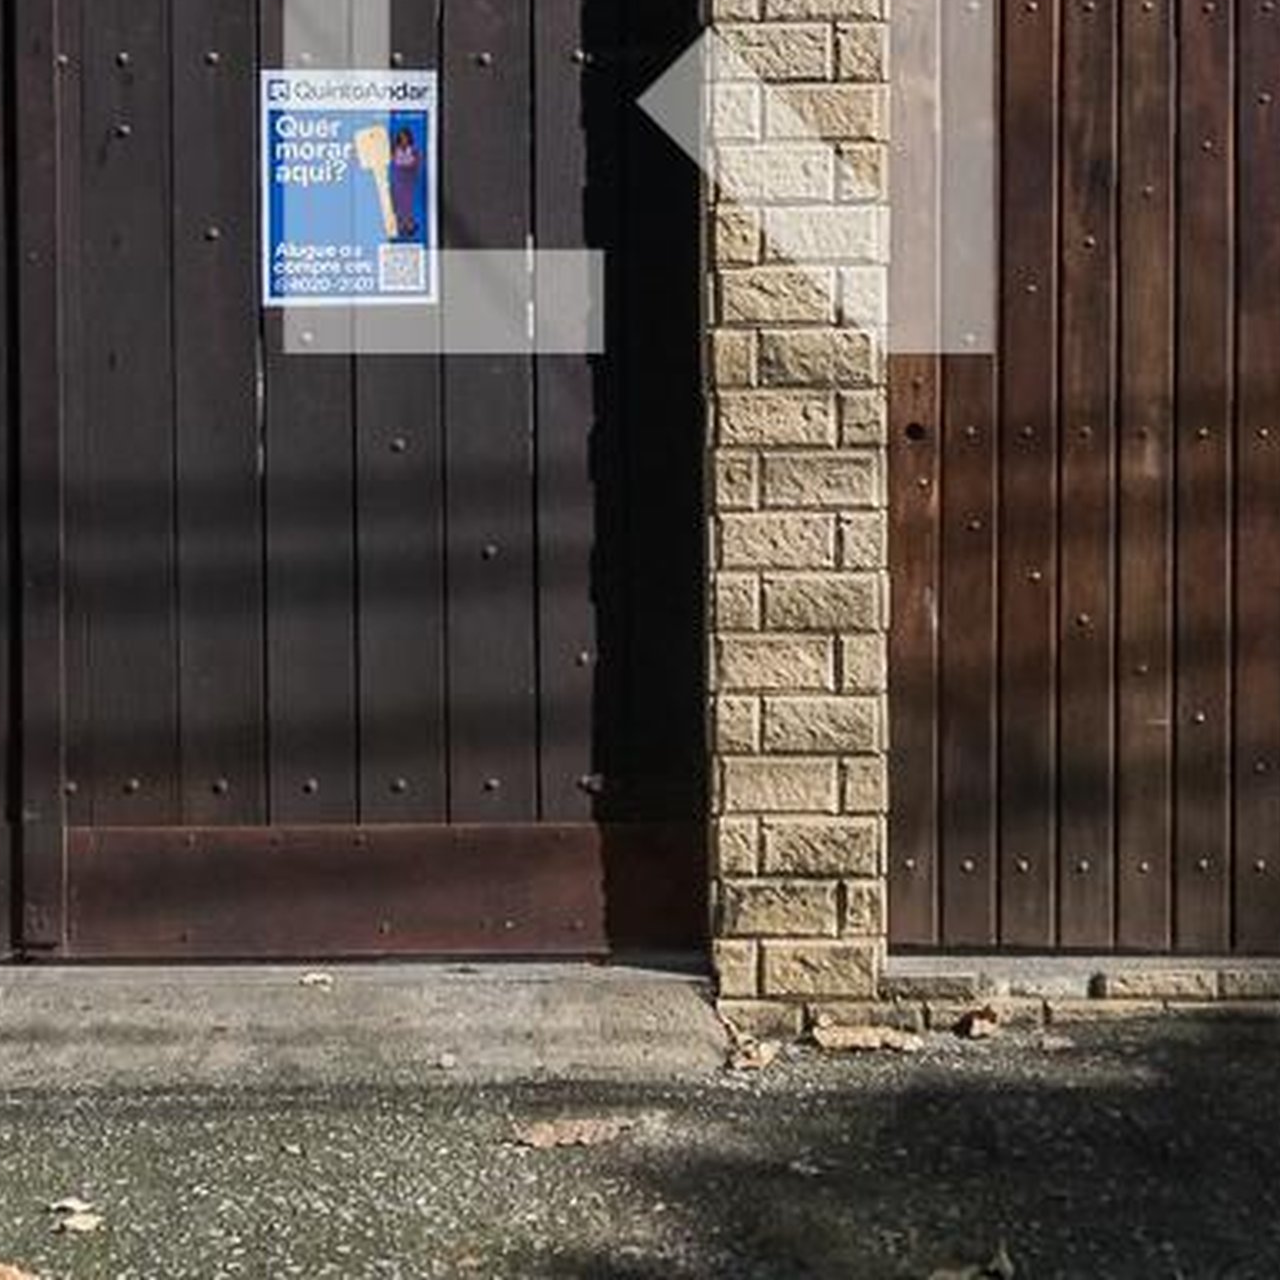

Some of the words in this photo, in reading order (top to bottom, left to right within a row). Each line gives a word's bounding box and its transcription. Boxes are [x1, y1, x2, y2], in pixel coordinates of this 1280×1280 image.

[294, 80, 428, 101] QuintoAndar
[275, 115, 342, 138] Quer
[275, 141, 352, 160] morar
[275, 159, 348, 188] aqui?
